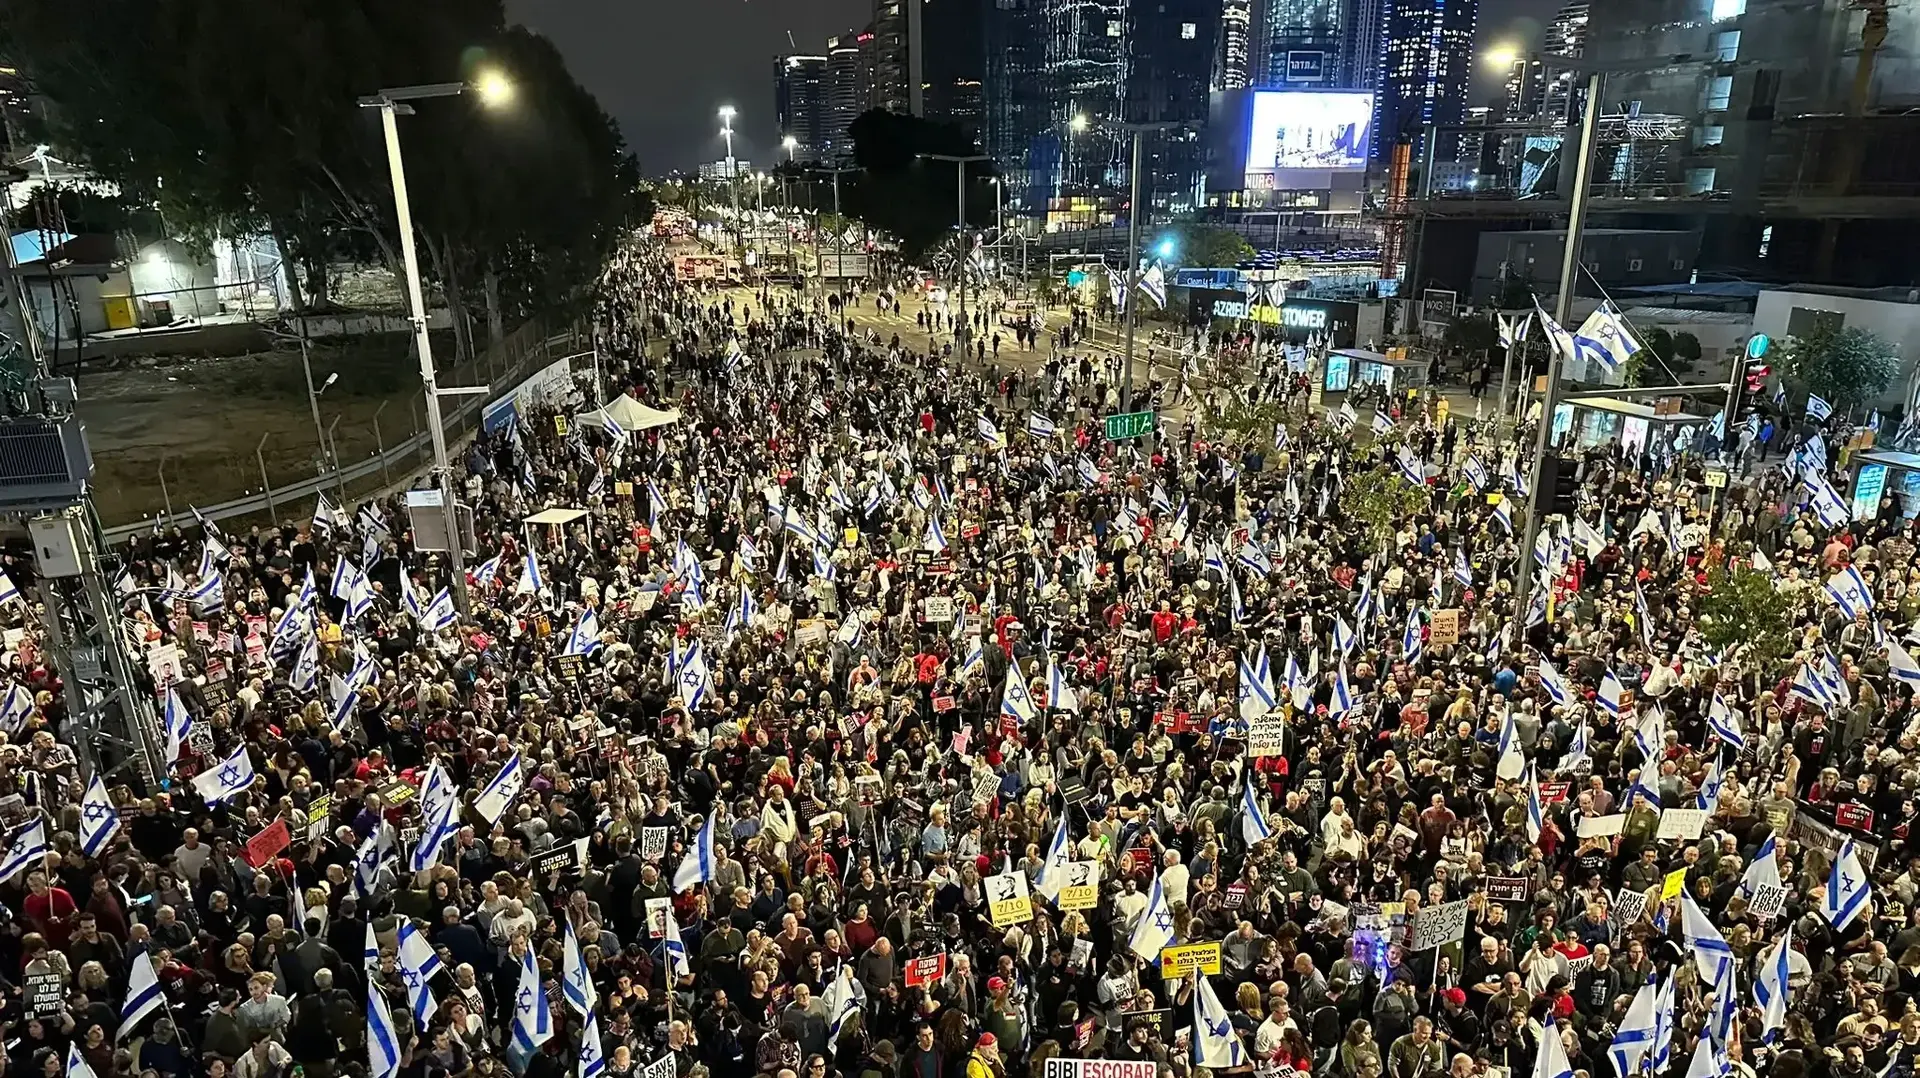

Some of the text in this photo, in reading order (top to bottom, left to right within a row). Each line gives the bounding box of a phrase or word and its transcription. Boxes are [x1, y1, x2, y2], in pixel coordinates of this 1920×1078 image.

[1284, 308, 1327, 331] TOWER
[1434, 630, 1455, 638] לשלם
[562, 668, 576, 677] NOW
[204, 690, 219, 700] DEAL
[207, 697, 221, 707] NOW
[1254, 715, 1281, 723] ממשלה
[1271, 739, 1281, 748] לא
[309, 804, 330, 824] HOME
[309, 816, 329, 841] NOW!
[645, 829, 665, 839] SAVE
[645, 838, 665, 847] THEM
[645, 846, 664, 855] FROM
[541, 853, 569, 866] עסקה
[540, 859, 571, 874] עכשיו!
[1067, 887, 1092, 898] 7/10
[1759, 884, 1785, 896] SAVE
[1621, 891, 1644, 902] SAVE
[1756, 892, 1782, 904] THEM
[997, 900, 1024, 912] 7/10
[1619, 899, 1641, 911] THEM
[1753, 900, 1778, 914] FROM
[1617, 906, 1639, 919] FROM
[919, 957, 938, 968] עסקה
[1194, 956, 1217, 964] בשביל
[1569, 958, 1591, 971] SAVE
[914, 965, 938, 977] עכשיו!
[38, 983, 60, 993] יש לנו
[33, 993, 60, 1003] ממשלה
[648, 1056, 673, 1078] SAVE
[1048, 1061, 1155, 1078] BIBI ESCOBAR
